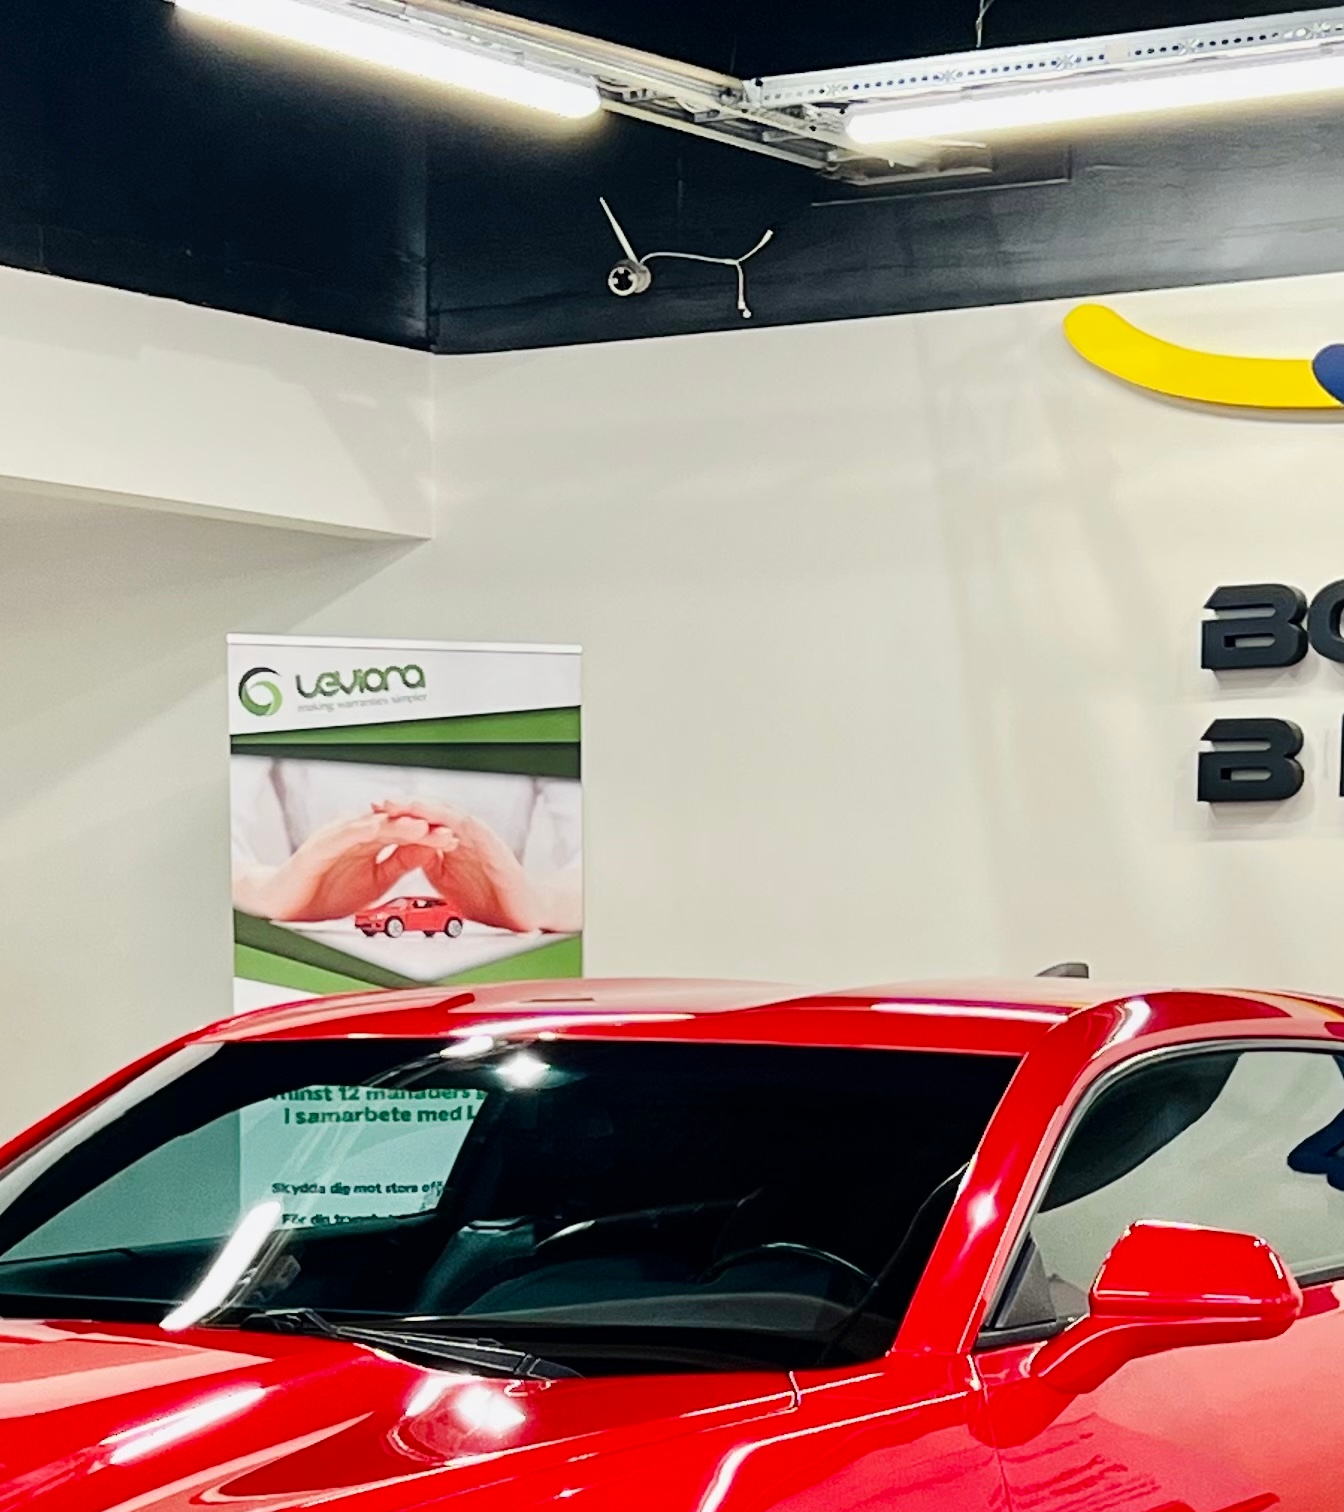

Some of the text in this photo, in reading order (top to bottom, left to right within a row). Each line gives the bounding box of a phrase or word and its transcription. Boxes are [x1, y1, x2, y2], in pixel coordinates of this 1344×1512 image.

[338, 1086, 360, 1101] 12
[295, 1107, 411, 1125] samarbete
[417, 1105, 462, 1122] med
[354, 1183, 381, 1194] mot
